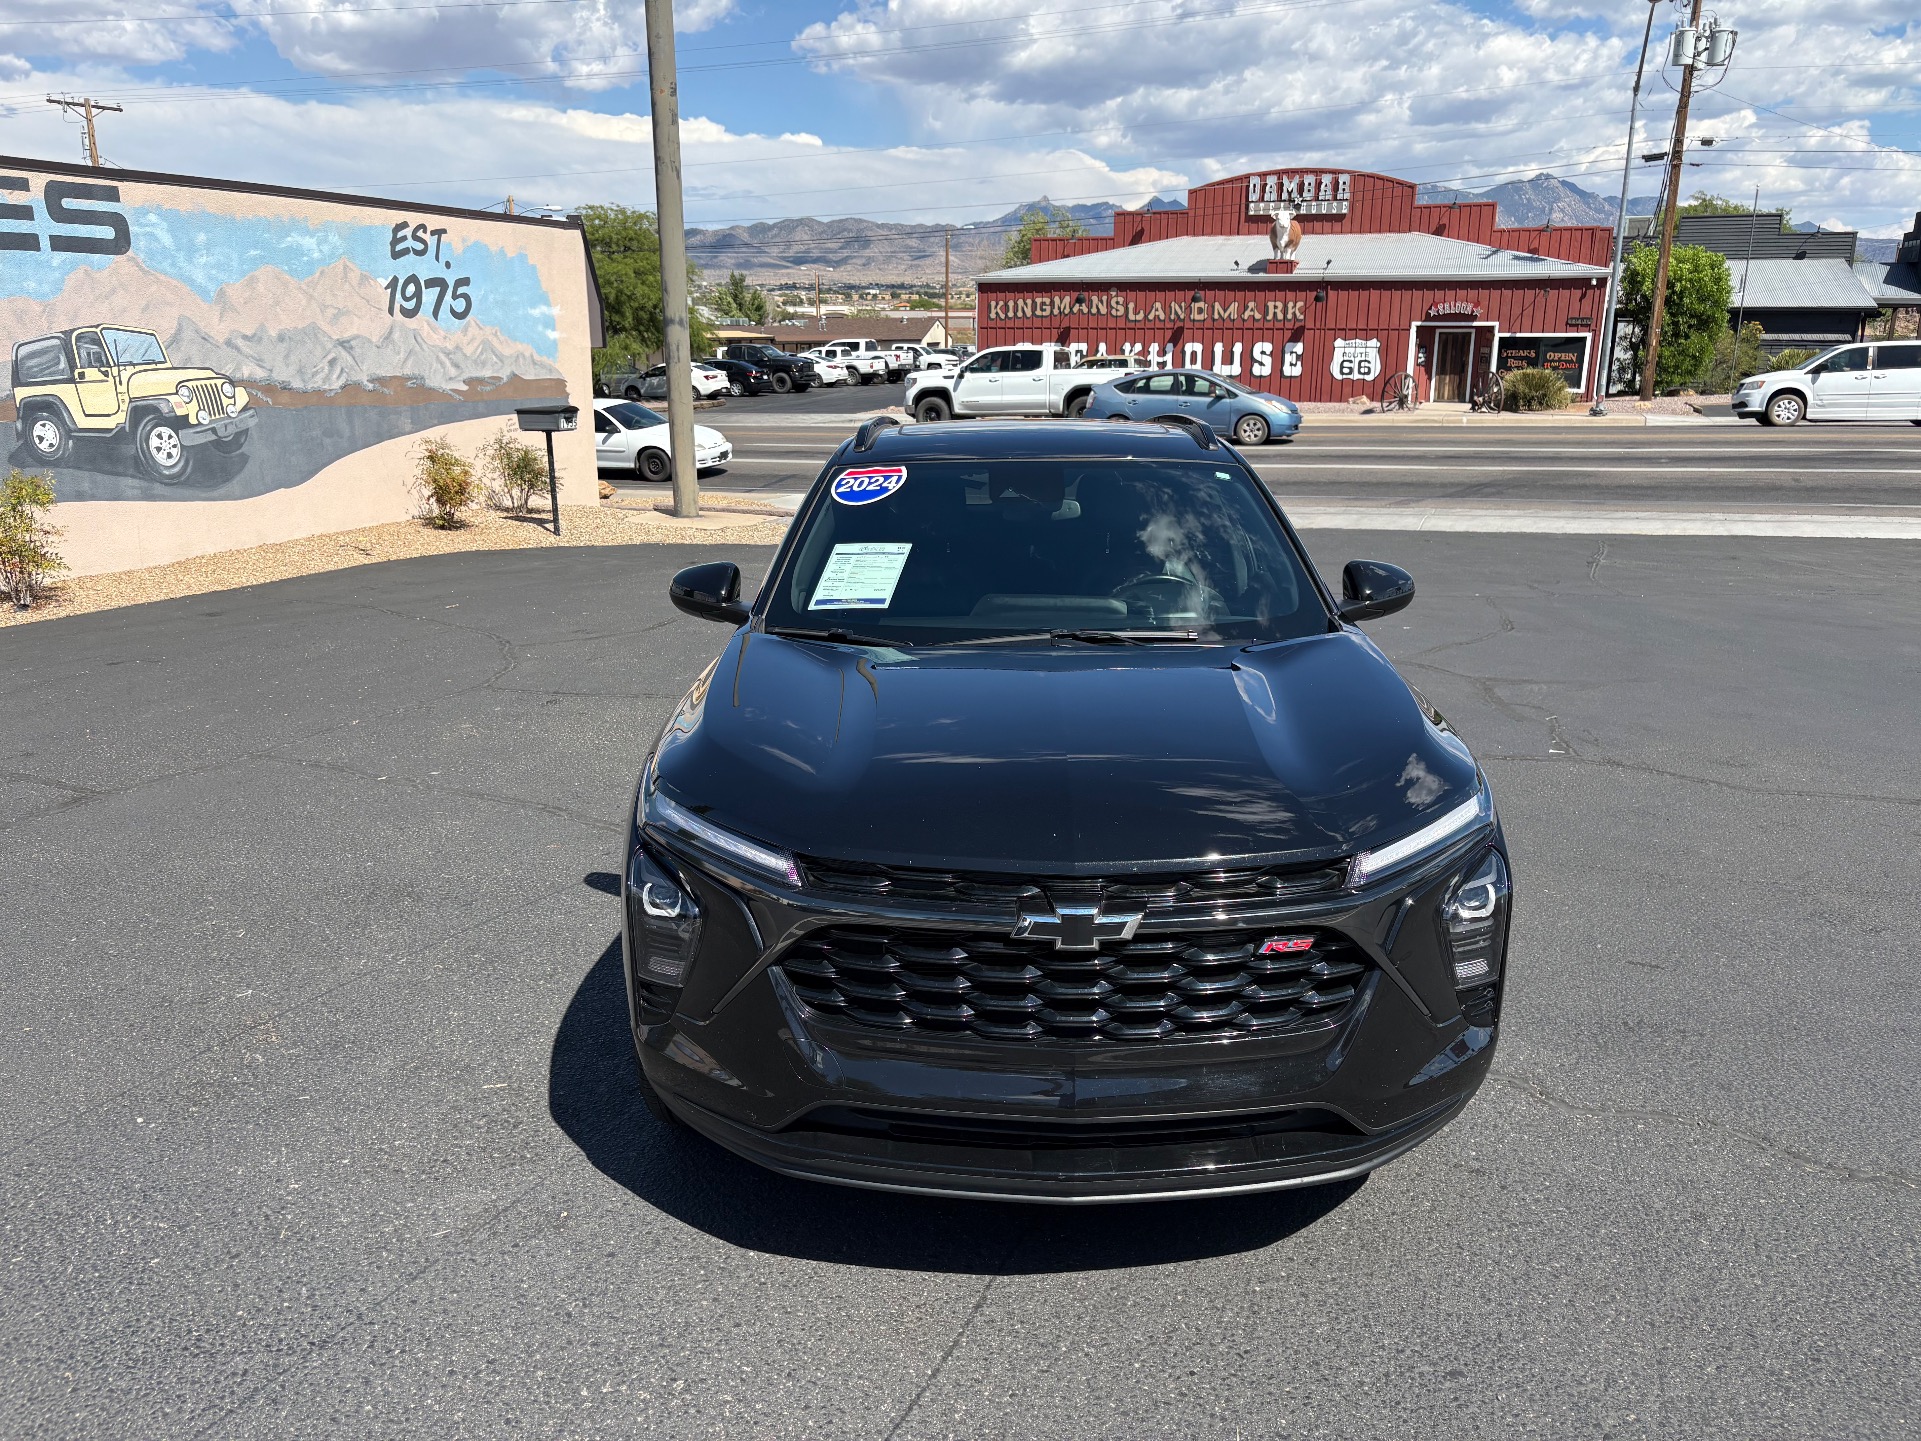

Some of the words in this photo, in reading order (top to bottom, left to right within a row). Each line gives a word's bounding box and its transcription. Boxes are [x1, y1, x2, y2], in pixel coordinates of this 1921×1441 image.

[1249, 174, 1350, 201] DAMBAR
[389, 220, 452, 270] EST.
[384, 273, 472, 321] 1975
[1127, 300, 1305, 322] LANDMARK
[1437, 301, 1474, 314] SALOON
[1342, 351, 1370, 359] ROUTE
[1547, 352, 1577, 362] OPEN
[1340, 359, 1371, 376] 66
[836, 475, 899, 493] 2024
[1258, 938, 1315, 954] RS
